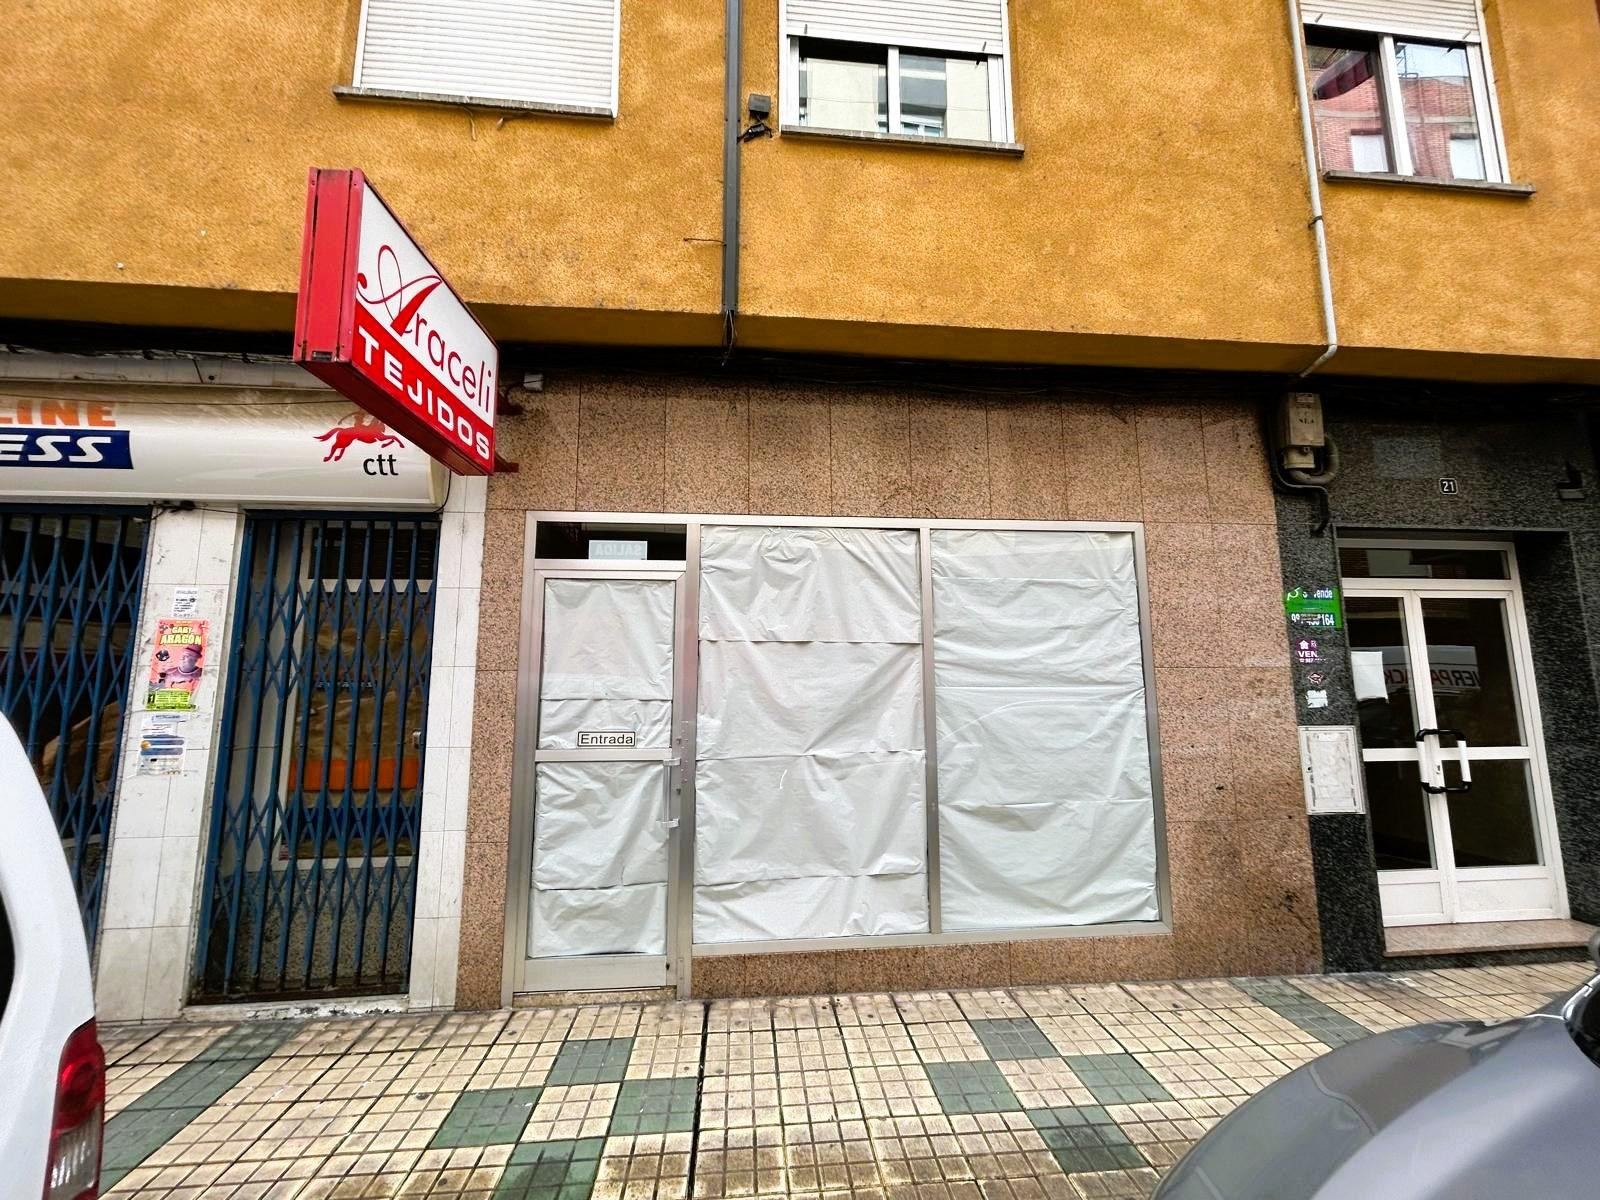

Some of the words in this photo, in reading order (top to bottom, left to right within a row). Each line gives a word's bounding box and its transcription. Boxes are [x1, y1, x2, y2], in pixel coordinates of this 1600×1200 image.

[357, 244, 492, 414] Araceli
[358, 325, 490, 461] TEJIDOS
[363, 454, 399, 476] ctt
[1442, 481, 1454, 491] 21
[580, 734, 634, 746] Entrada
